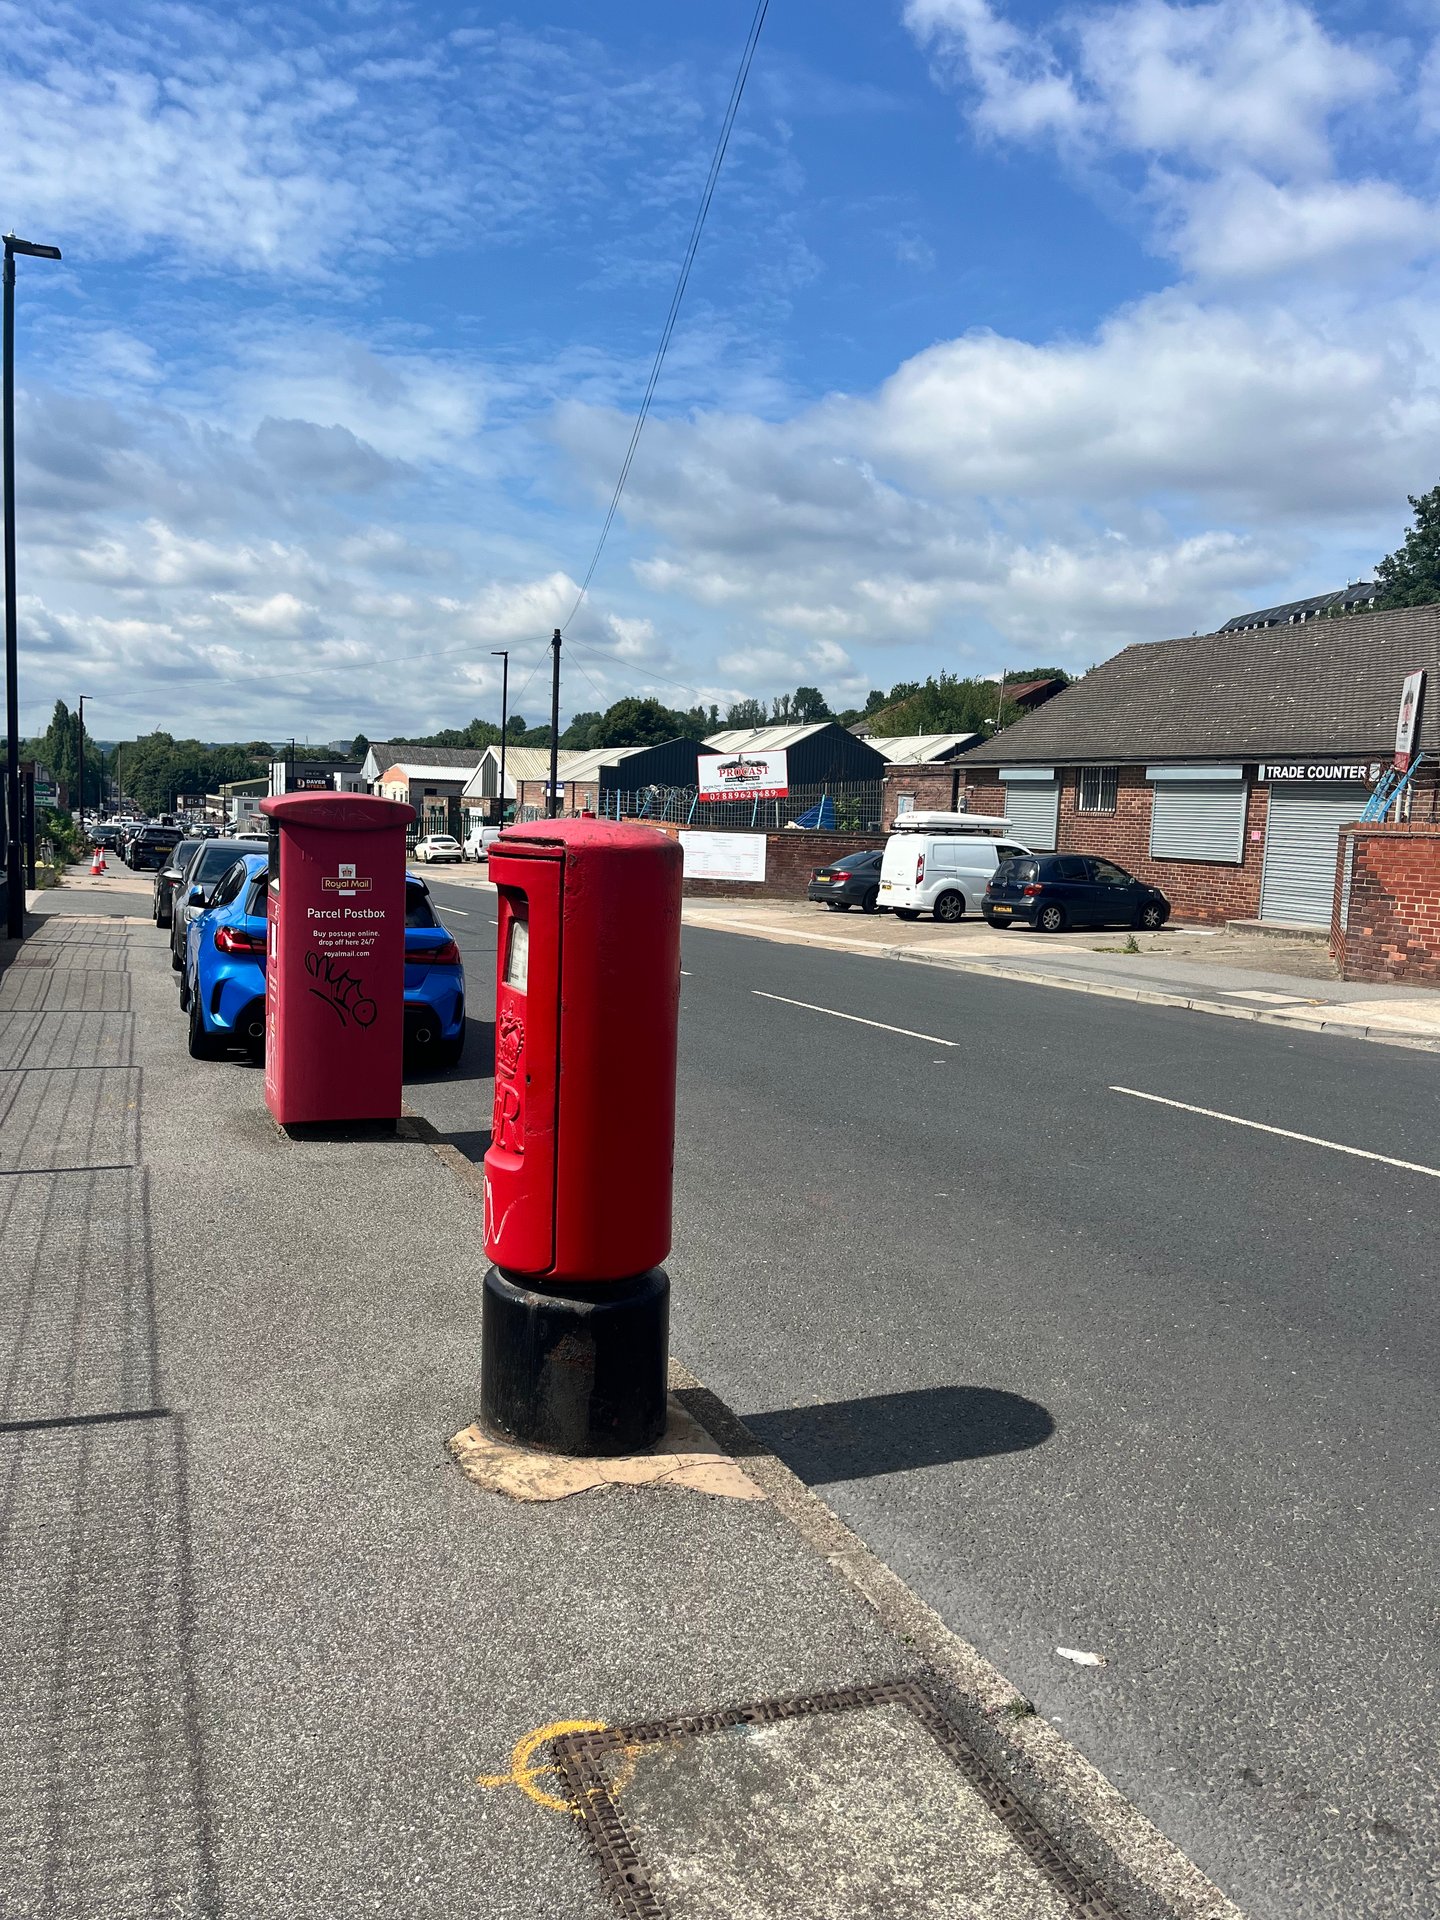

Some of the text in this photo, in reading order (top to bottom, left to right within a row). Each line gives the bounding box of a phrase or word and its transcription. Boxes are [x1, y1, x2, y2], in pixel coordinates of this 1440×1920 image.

[719, 766, 769, 777] PROCAST
[1266, 766, 1367, 779] TRADE COUNTER
[325, 880, 369, 889] Royal Mail
[307, 907, 386, 919] Parcel Postbox
[313, 930, 327, 938] Buy
[318, 939, 334, 947] drop
[360, 938, 375, 946] 24/7
[324, 950, 370, 959] royalmail.com
